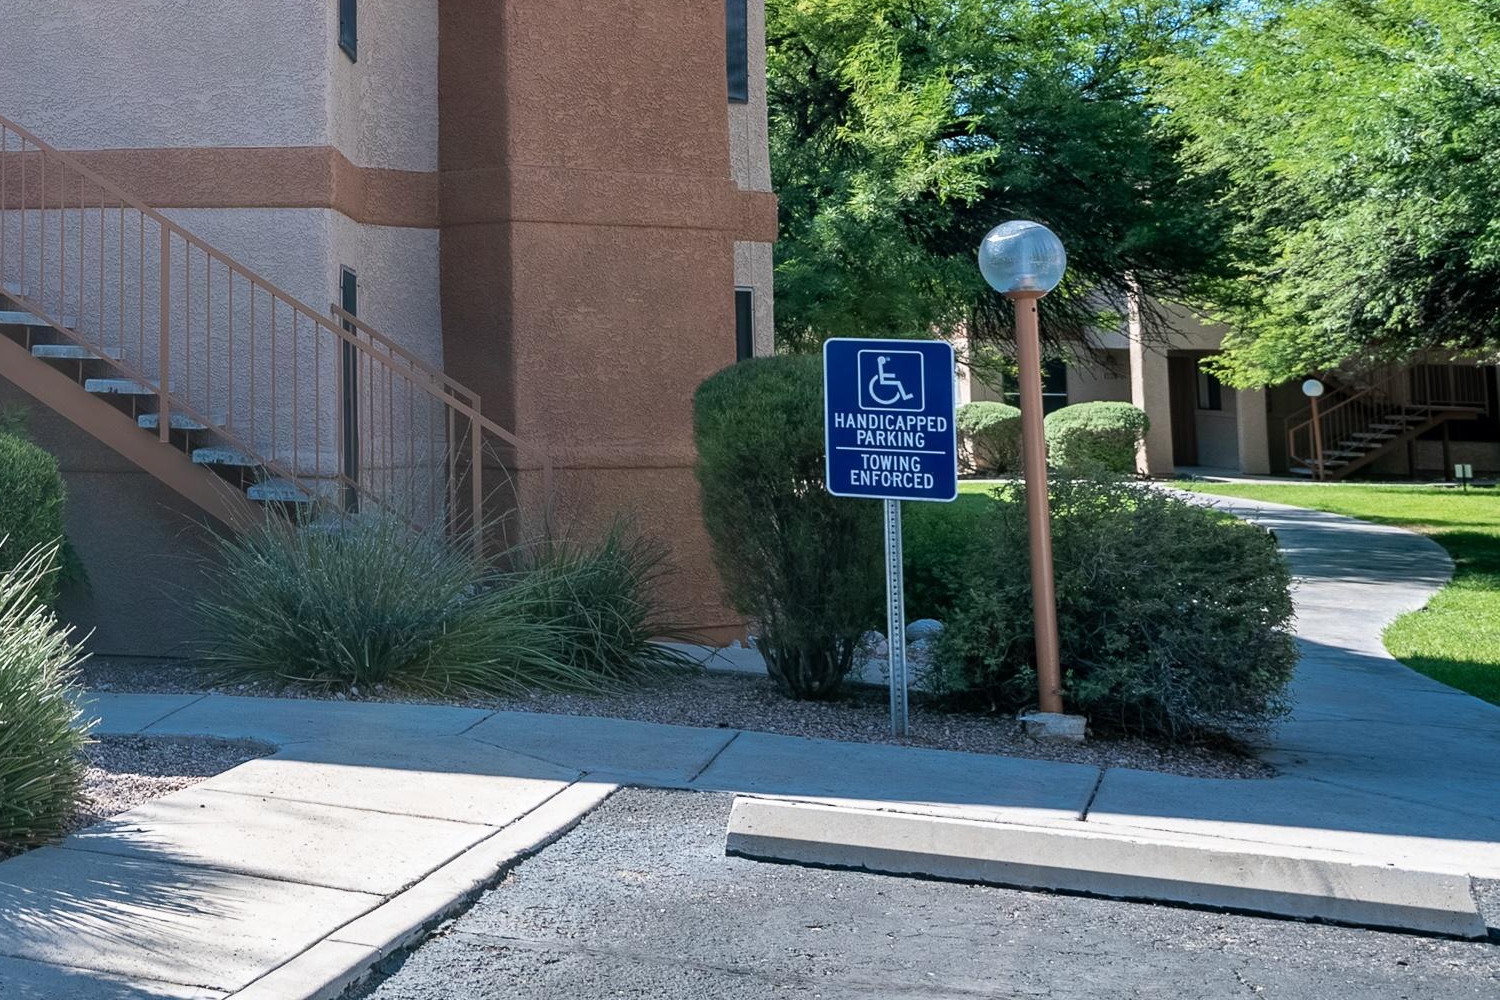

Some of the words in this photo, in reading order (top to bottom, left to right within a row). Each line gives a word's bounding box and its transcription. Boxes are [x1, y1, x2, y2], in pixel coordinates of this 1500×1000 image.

[834, 412, 947, 432] HANDICAPPED
[856, 430, 925, 448] PARKING
[860, 454, 921, 471] TOWING
[850, 470, 934, 489] ENFORCED
